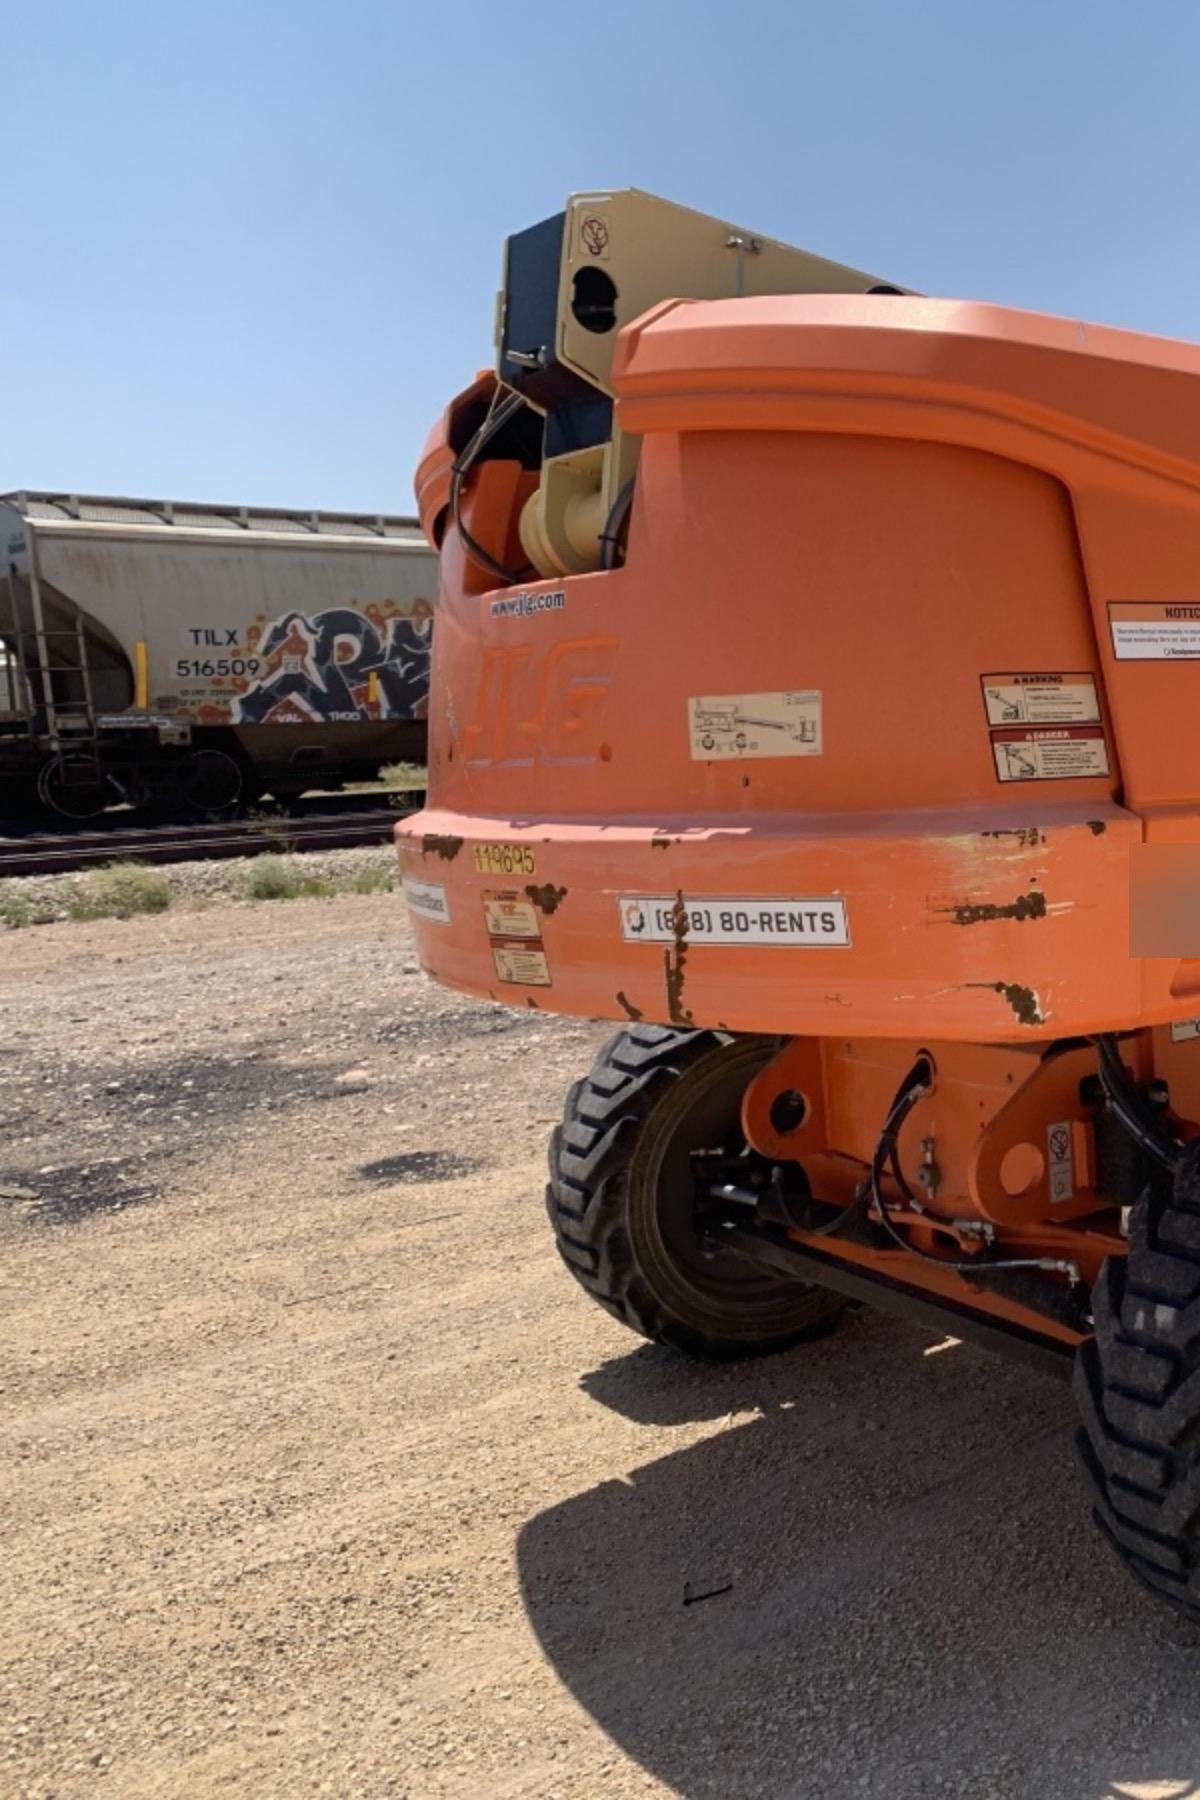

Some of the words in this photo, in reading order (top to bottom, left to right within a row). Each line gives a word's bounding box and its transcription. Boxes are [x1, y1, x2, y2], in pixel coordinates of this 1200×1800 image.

[491, 591, 566, 618] www.jlg.com
[189, 629, 239, 646] TILX
[176, 659, 260, 677] 516509
[720, 911, 836, 933] 80-RENTS
